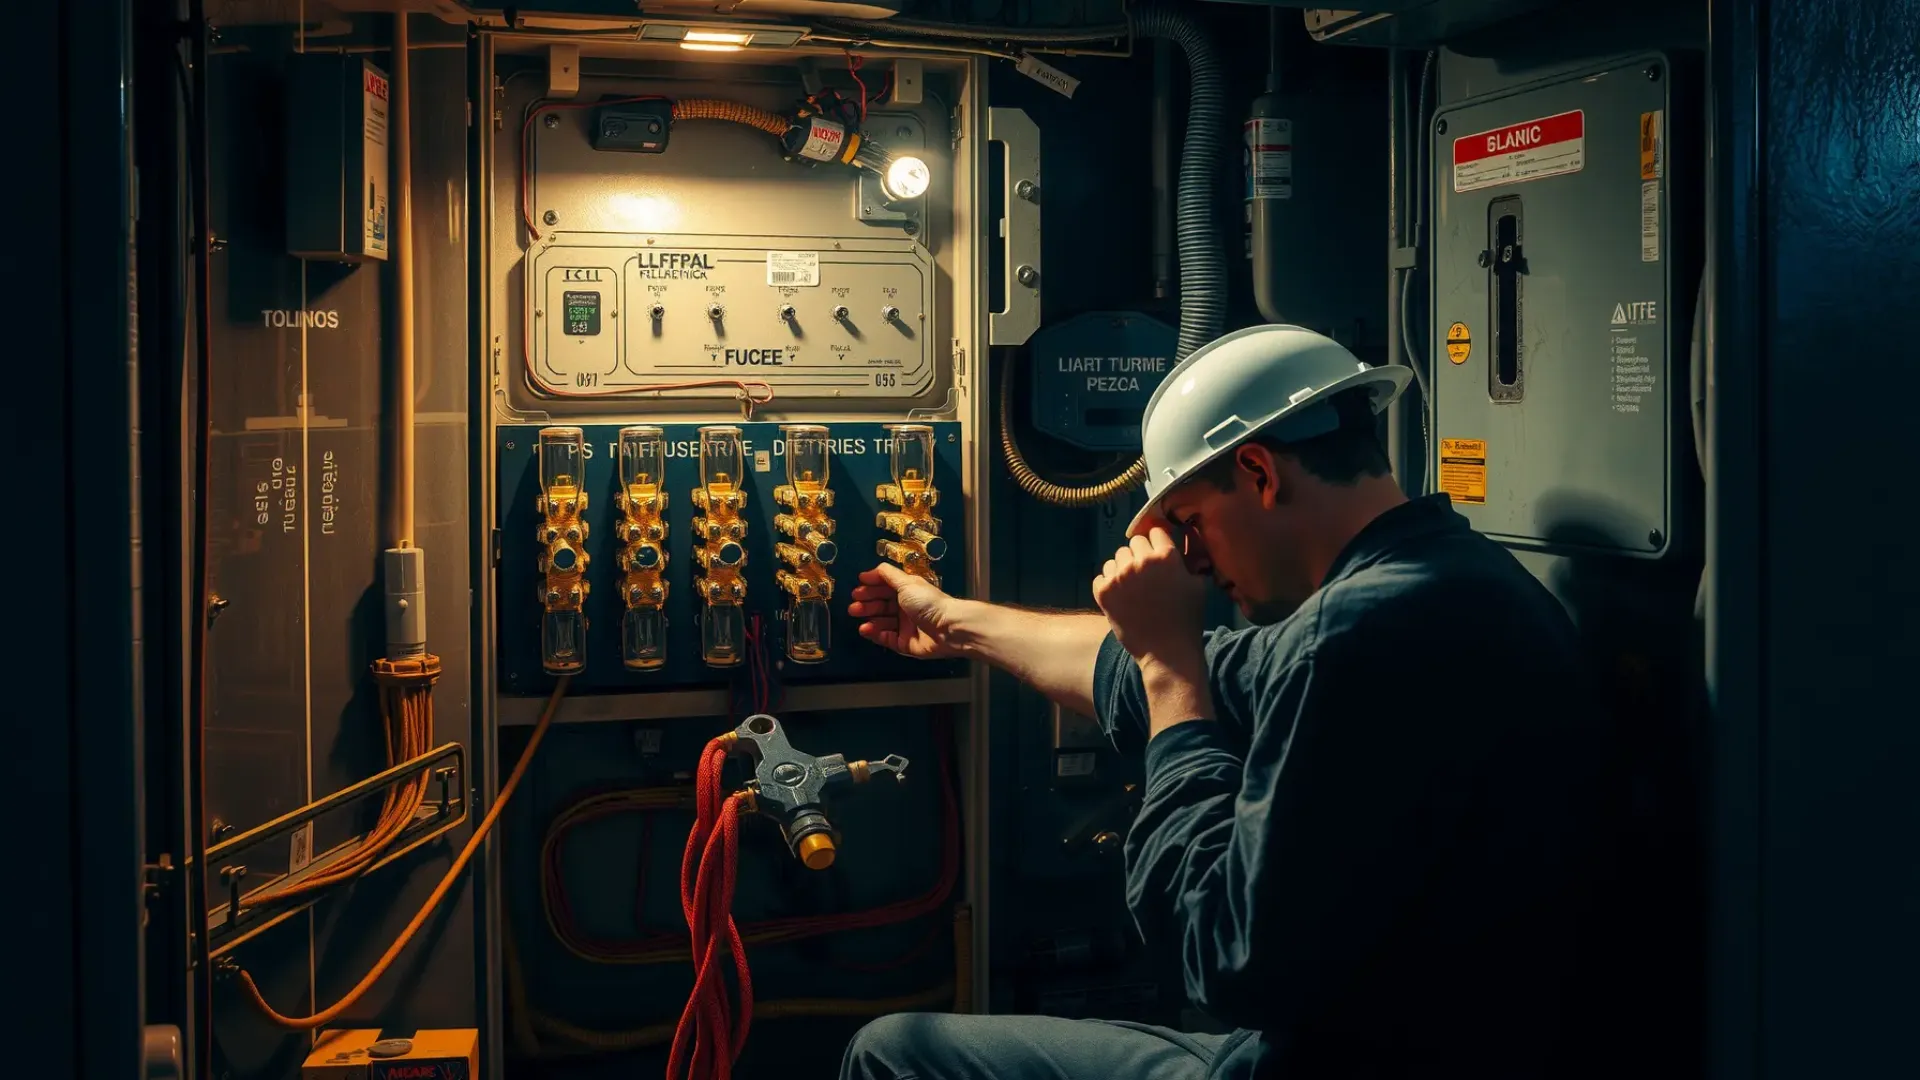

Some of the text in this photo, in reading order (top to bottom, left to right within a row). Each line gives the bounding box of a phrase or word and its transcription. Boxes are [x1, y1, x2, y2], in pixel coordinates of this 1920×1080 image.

[261, 309, 339, 328] TOLINOS
[725, 349, 783, 365] FUCEE
[1058, 357, 1103, 372] LIART
[1087, 377, 1140, 391] PEZCA
